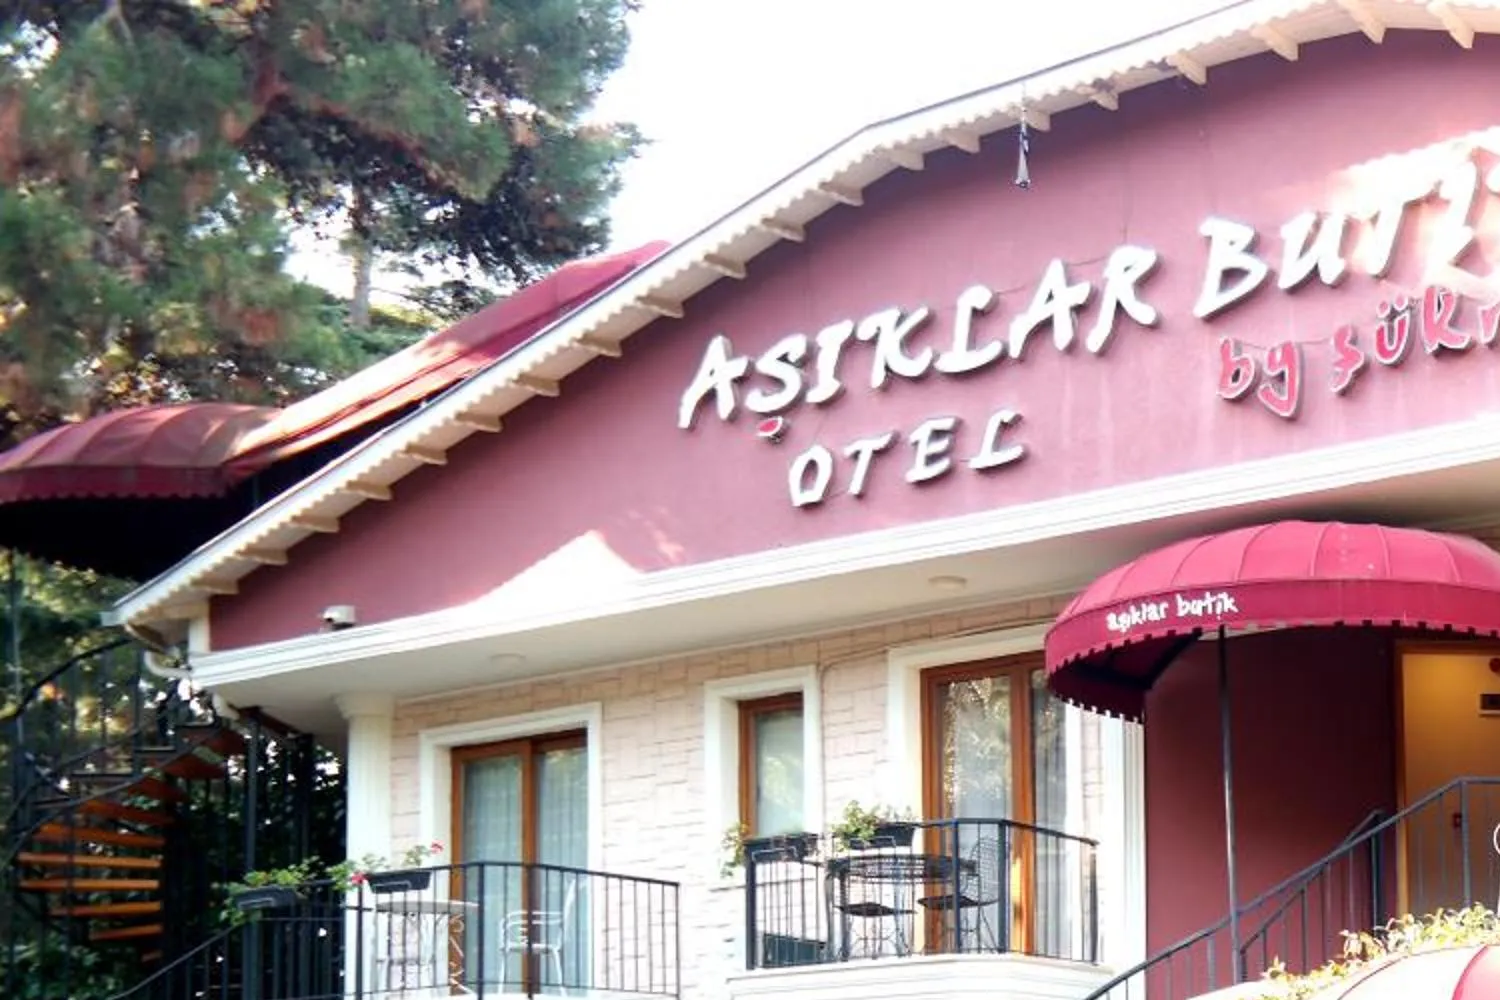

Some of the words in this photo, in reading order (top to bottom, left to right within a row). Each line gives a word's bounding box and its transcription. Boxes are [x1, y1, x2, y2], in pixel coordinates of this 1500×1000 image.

[678, 244, 1159, 440] AŞIKLAR
[1216, 336, 1299, 418] by
[787, 409, 1024, 508] OTEL
